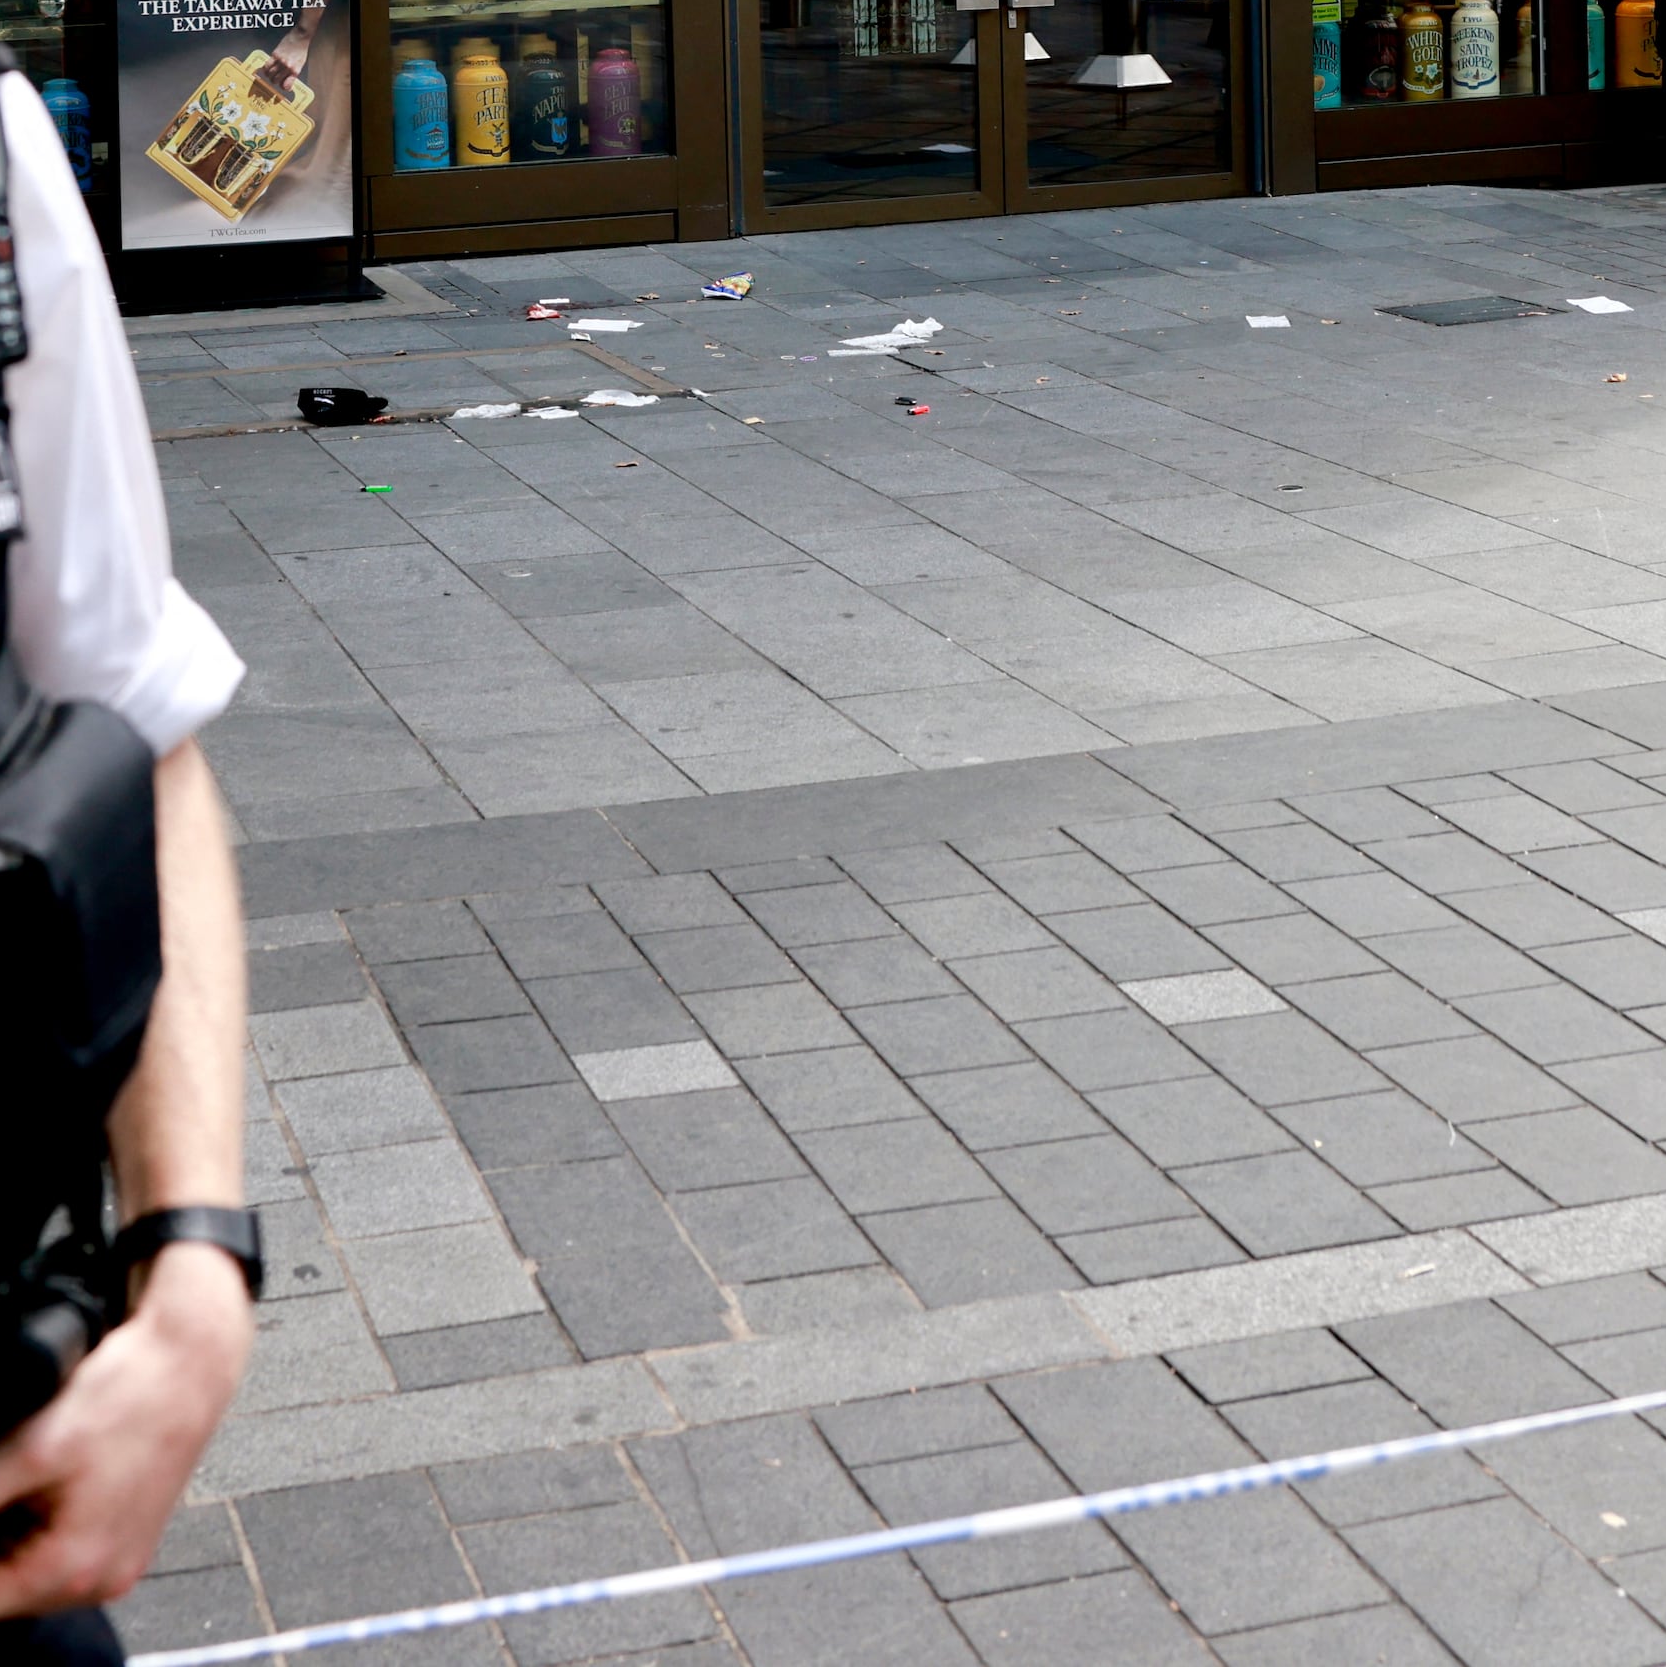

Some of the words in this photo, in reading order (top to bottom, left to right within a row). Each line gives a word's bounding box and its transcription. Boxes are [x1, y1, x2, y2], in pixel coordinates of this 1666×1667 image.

[138, 0, 181, 16] THE
[172, 12, 295, 33] EXPERIENCE
[1453, 27, 1495, 45] WEEKEND
[1459, 43, 1490, 58] SAINT
[1455, 55, 1494, 72] TROPEZ
[208, 227, 267, 238] TWGTea.com
